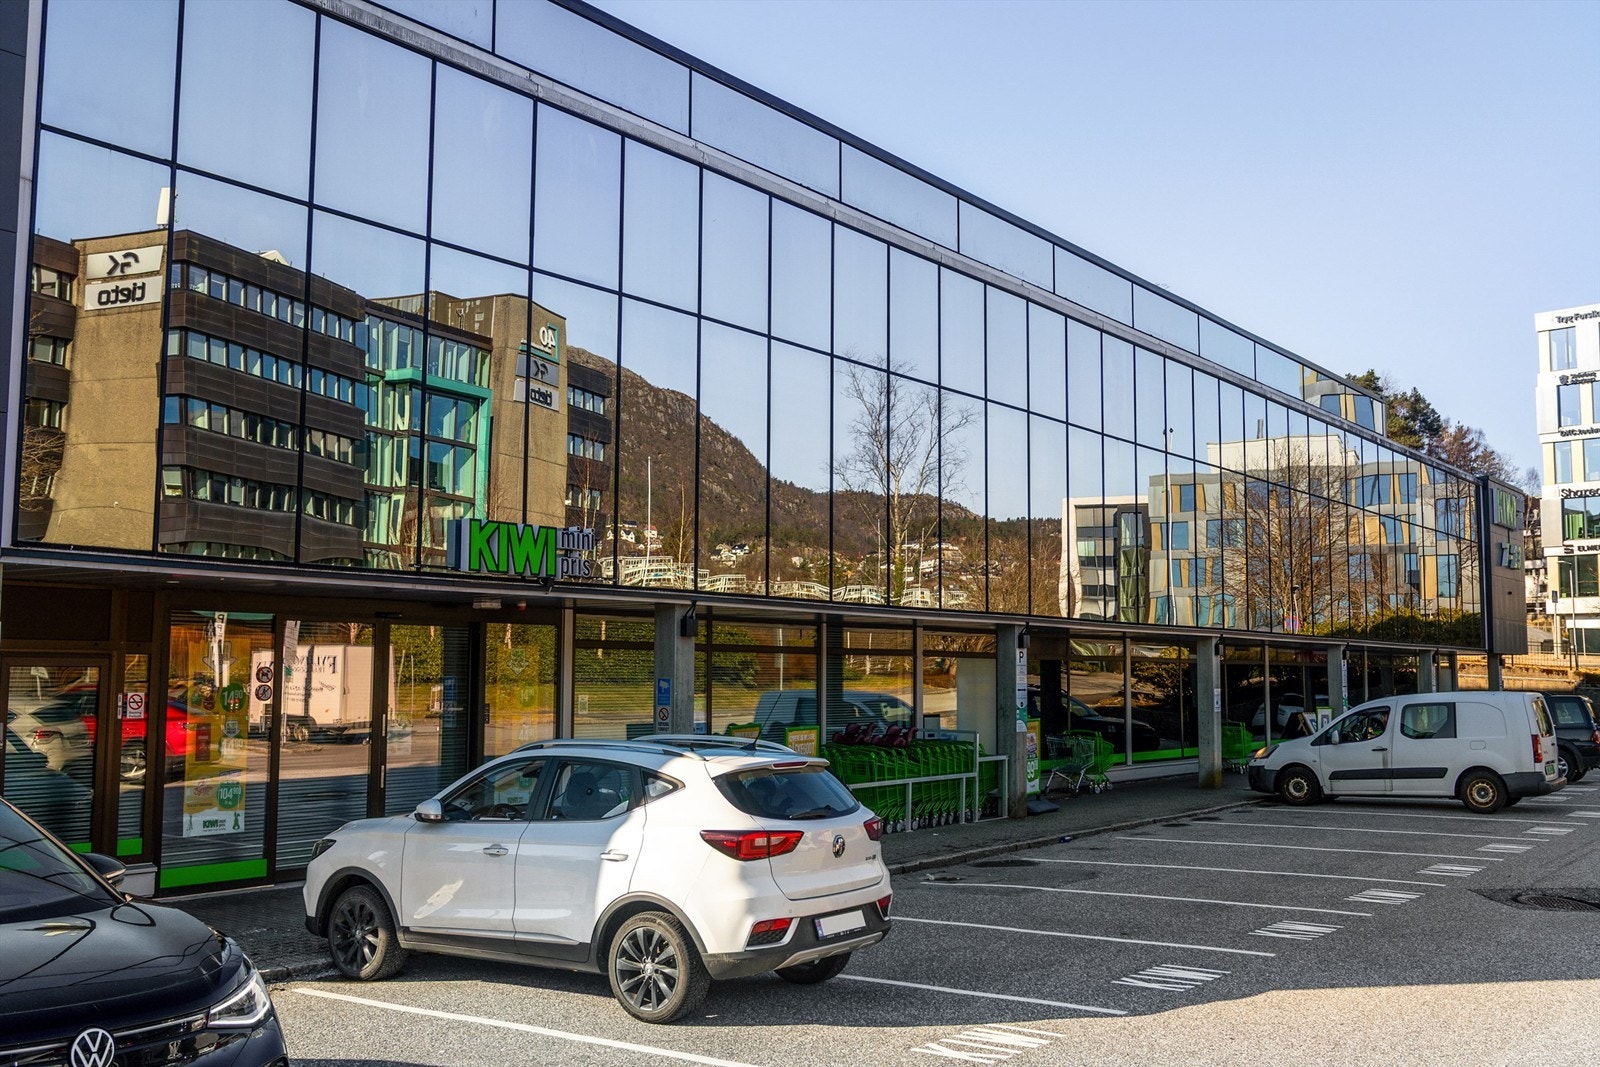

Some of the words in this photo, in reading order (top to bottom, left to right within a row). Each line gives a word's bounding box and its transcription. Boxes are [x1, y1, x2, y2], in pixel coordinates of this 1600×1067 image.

[469, 518, 557, 577] KIWI
[560, 526, 596, 551] mini
[560, 552, 592, 578] pris
